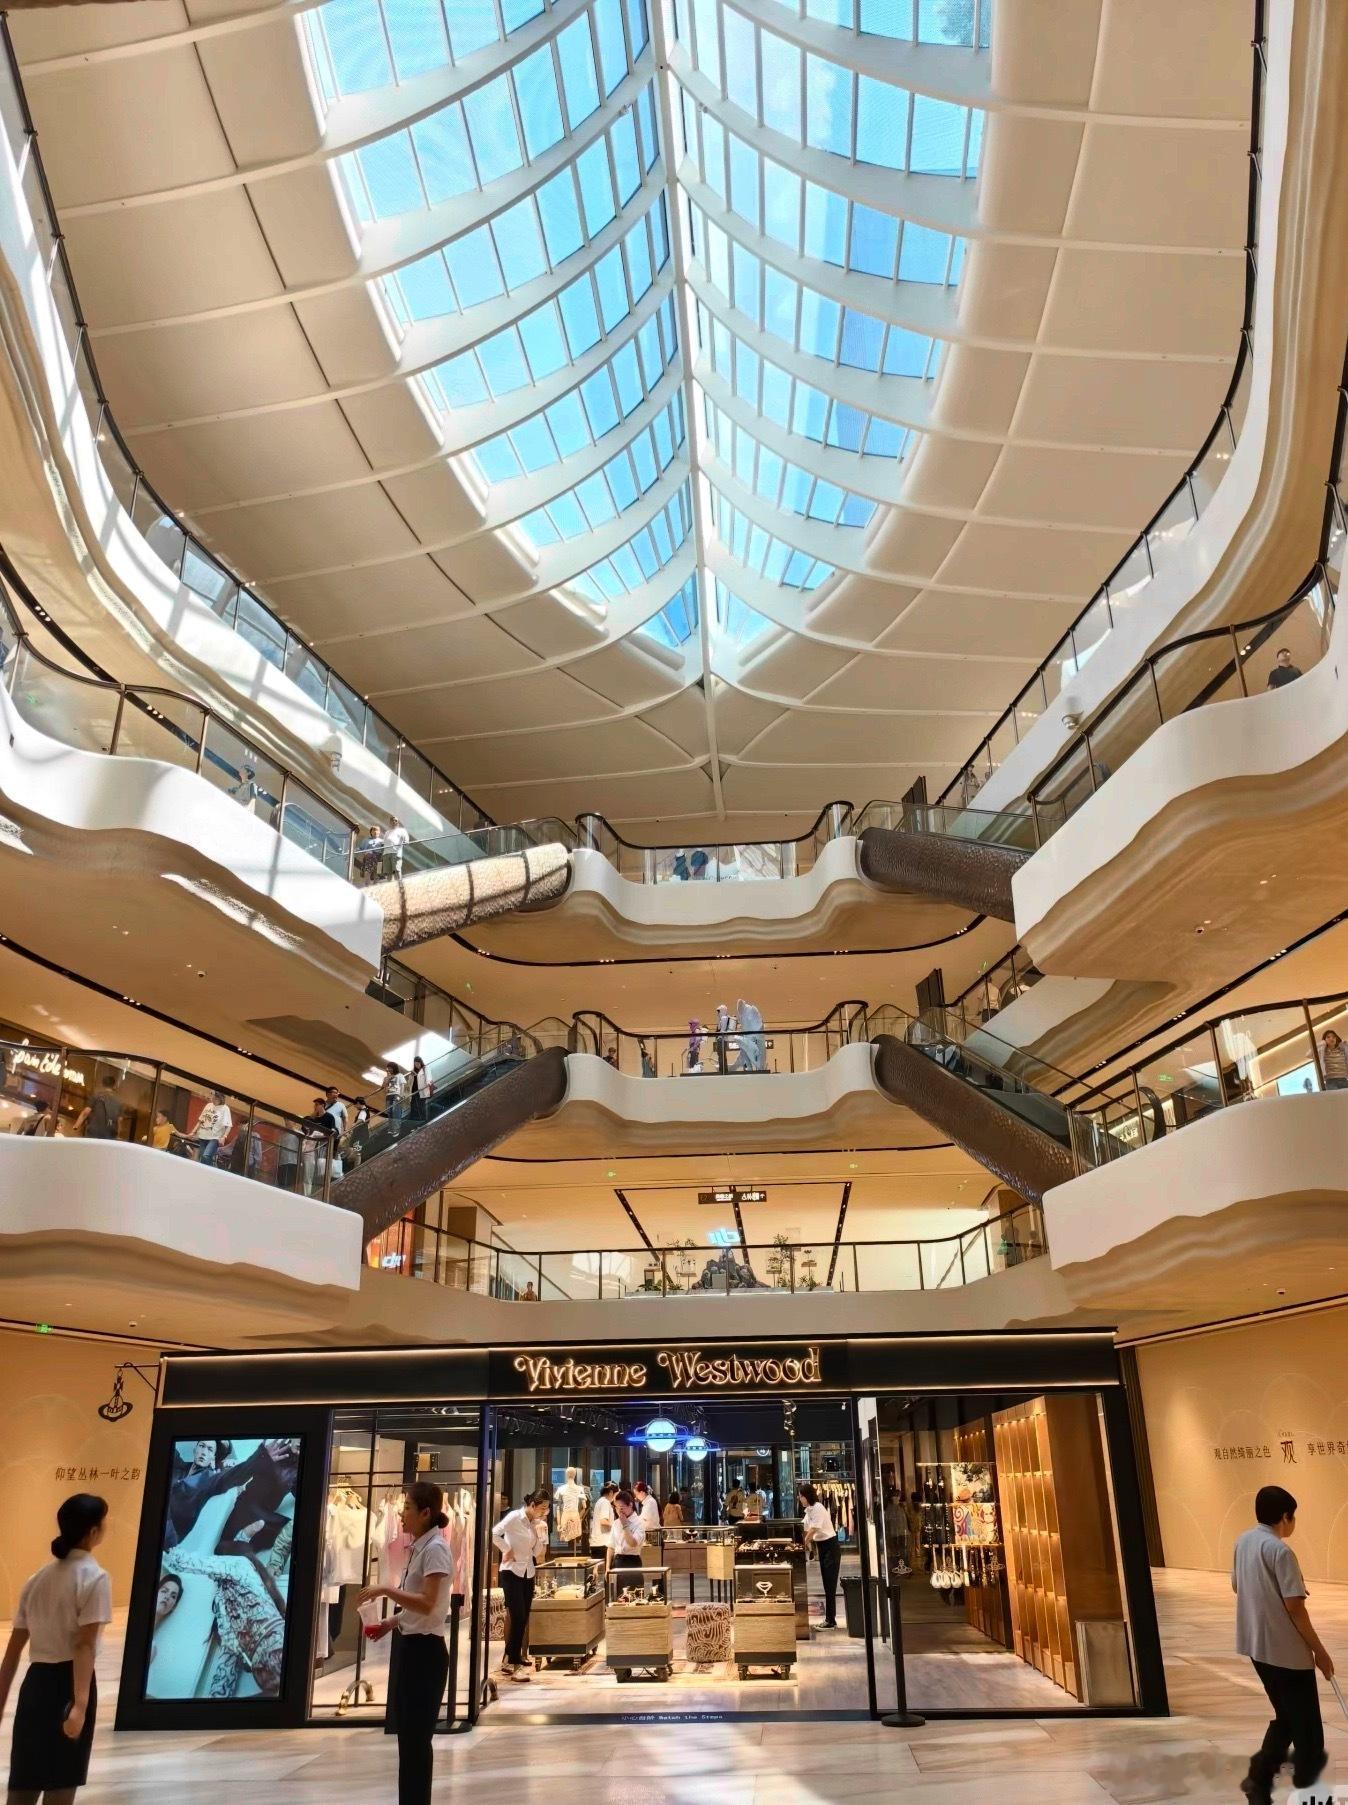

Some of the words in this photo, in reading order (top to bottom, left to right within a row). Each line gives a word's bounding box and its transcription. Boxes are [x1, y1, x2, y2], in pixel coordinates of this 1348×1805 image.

[513, 1354, 648, 1392] Vivienne
[656, 1346, 822, 1388] Westwood
[1306, 1440, 1348, 1456] 享世界奇
[55, 1466, 141, 1481] 仰望丛林一叶之韵
